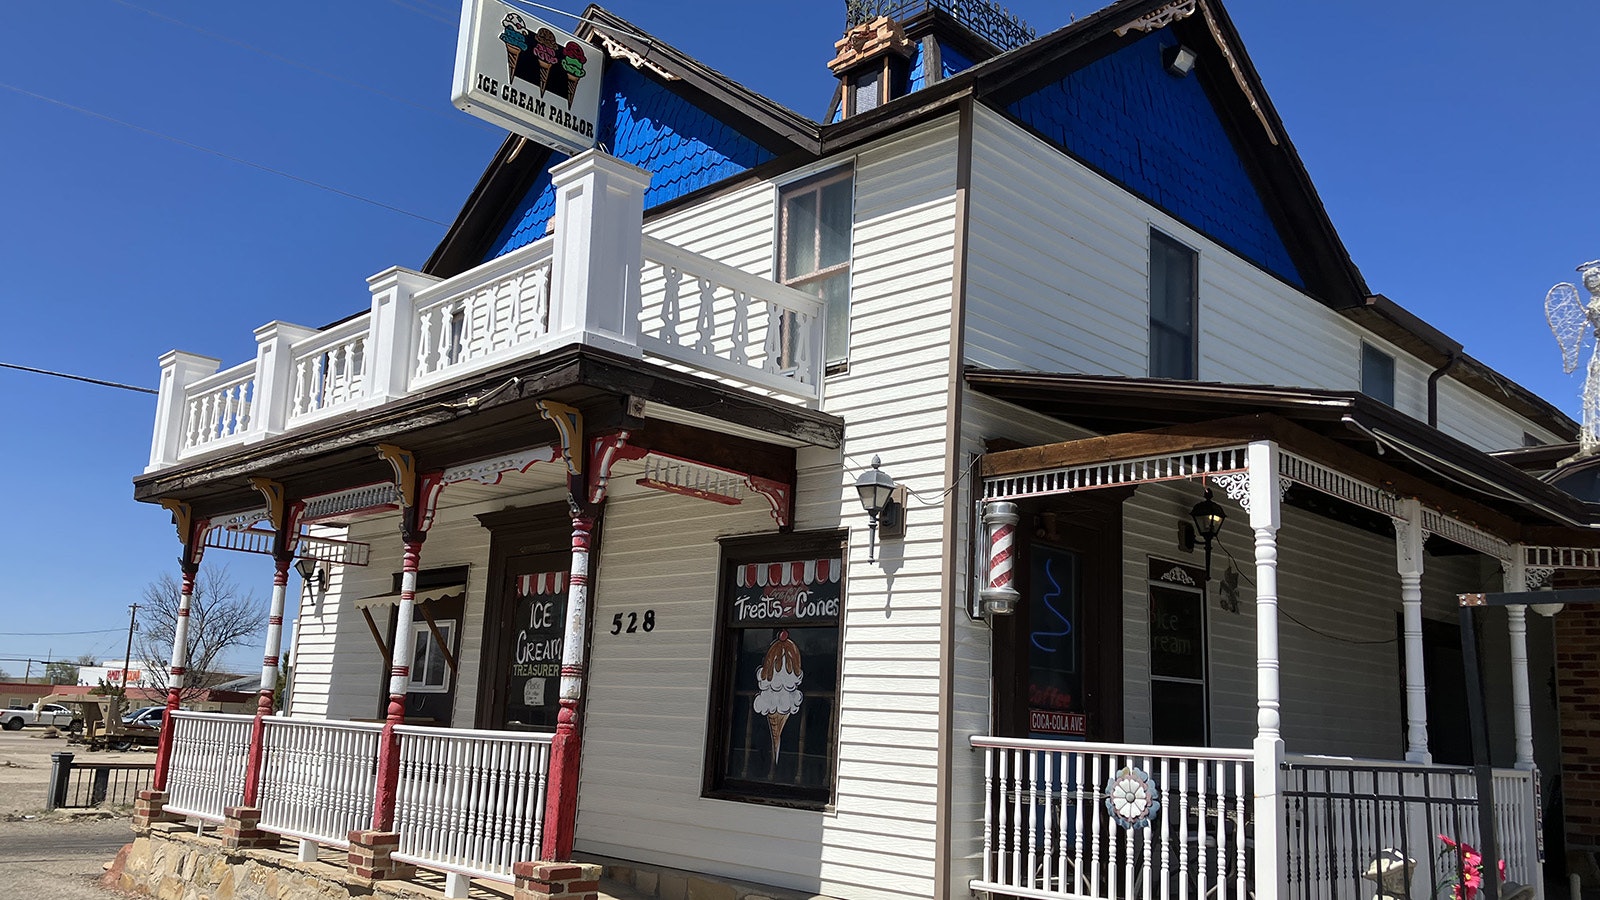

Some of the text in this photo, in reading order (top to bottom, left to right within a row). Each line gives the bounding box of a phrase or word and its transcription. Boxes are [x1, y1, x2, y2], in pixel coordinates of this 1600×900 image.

[477, 73, 594, 139] ICE CREAM PARLOR
[530, 602, 554, 630] ICE
[734, 595, 783, 621] Treats
[795, 590, 840, 619] Cones
[610, 609, 656, 635] 528
[513, 664, 560, 677] TREASURER
[1032, 712, 1069, 731] COCA-COLA
